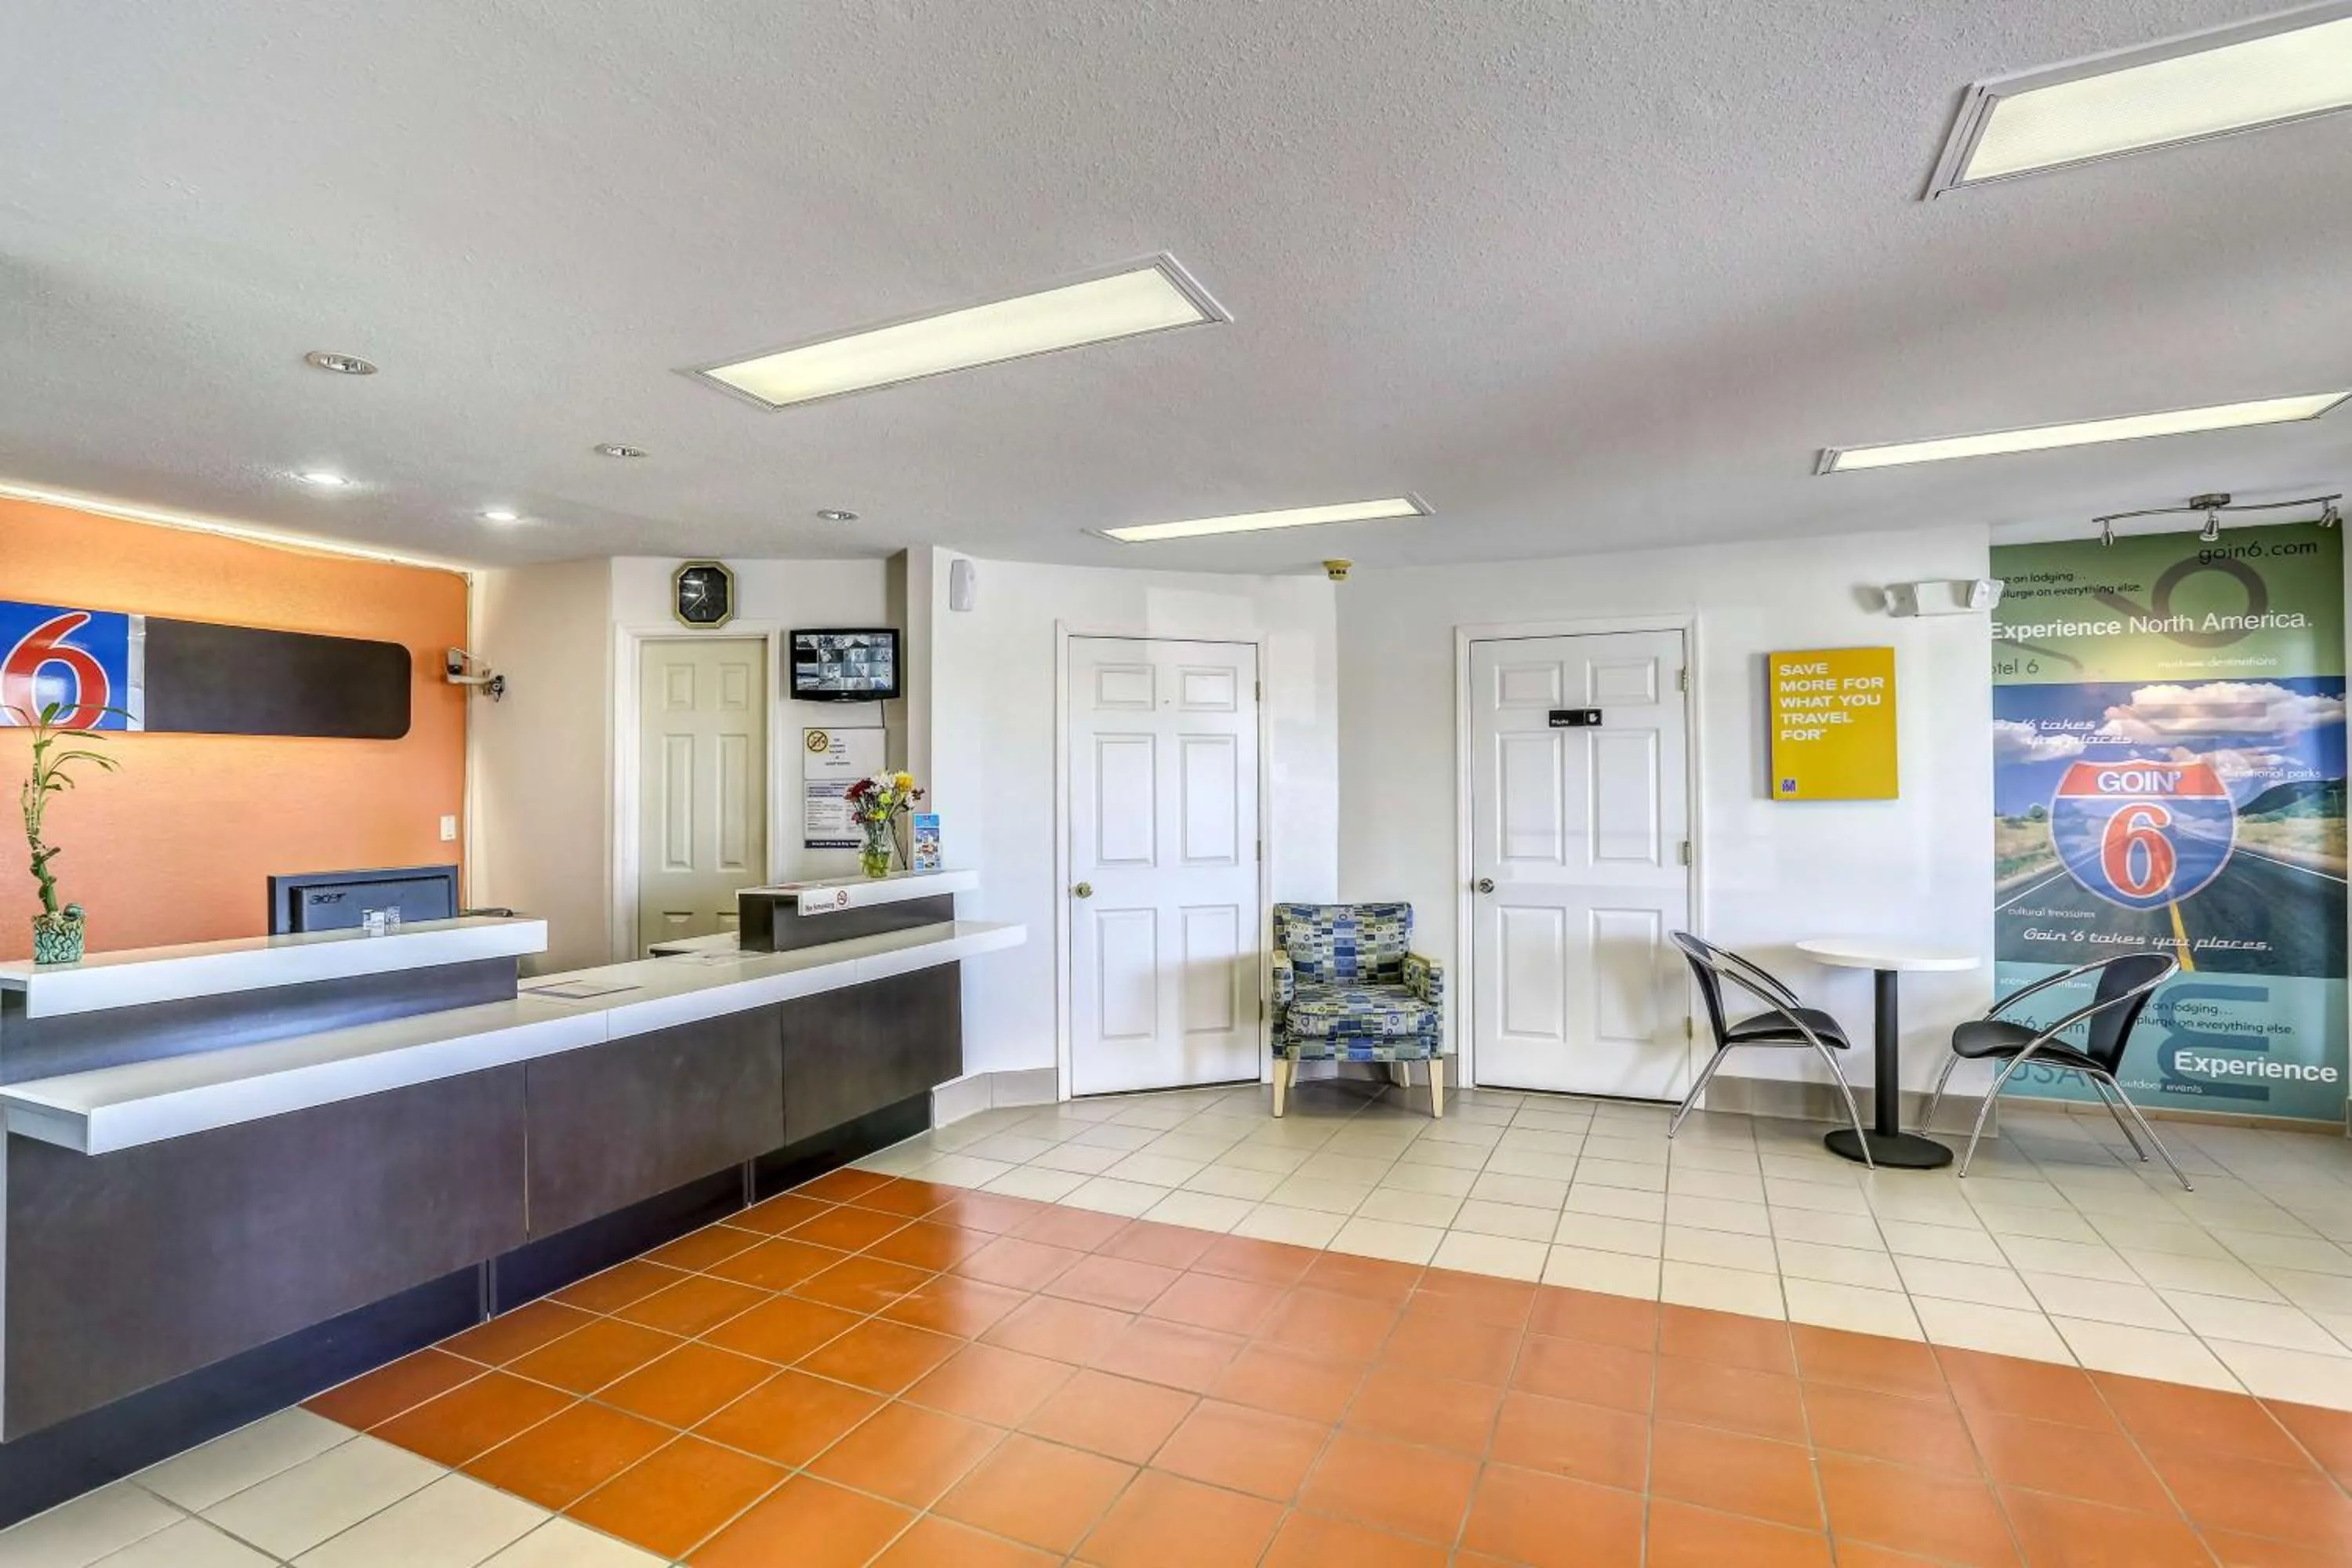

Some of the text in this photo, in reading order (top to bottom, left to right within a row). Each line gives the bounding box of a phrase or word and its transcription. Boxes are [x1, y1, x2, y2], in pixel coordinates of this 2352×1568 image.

[2198, 541, 2318, 564] goin6.com
[2036, 588, 2053, 597] on
[2053, 584, 2114, 597] everything
[1991, 610, 2314, 643] Experience North America.
[0, 612, 111, 729] 6
[1780, 663, 1828, 676] SAVE
[2027, 659, 2039, 674] 6
[1780, 677, 1885, 692] MORE FOR
[1780, 695, 1881, 708] WHAT YOU
[1780, 712, 1853, 724] TRAVEL
[2287, 767, 2321, 780] parks
[2097, 770, 2182, 793] GOIN'
[2100, 801, 2177, 898] 6
[2008, 906, 2045, 916] cultural
[2089, 933, 2146, 946] takes
[2152, 936, 2190, 950] you
[2194, 936, 2274, 952] places.
[2197, 1020, 2264, 1034] everything
[2174, 1051, 2339, 1083] Experience
[2165, 1083, 2203, 1094] events
